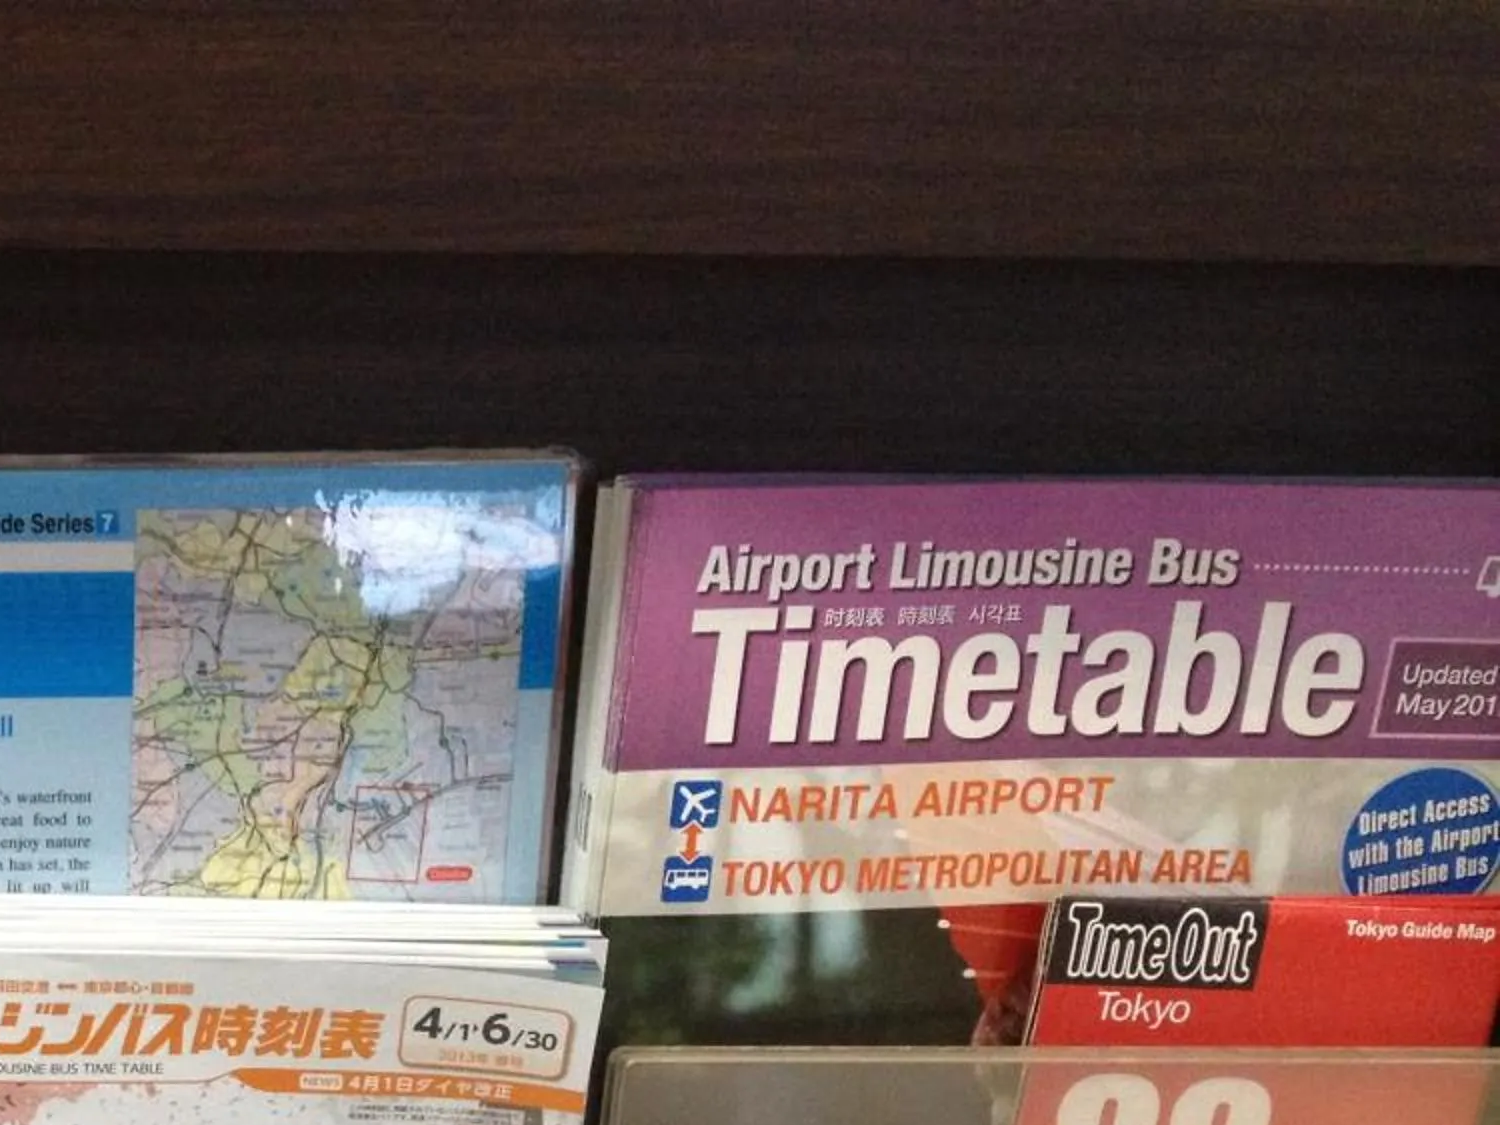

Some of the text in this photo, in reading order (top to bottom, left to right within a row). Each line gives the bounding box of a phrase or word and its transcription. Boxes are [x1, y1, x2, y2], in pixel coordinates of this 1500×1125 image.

[31, 512, 95, 535] Series
[696, 537, 1241, 601] Airport Limousine Bus
[691, 600, 1365, 745] Timetable
[1403, 663, 1498, 689] Updated
[1396, 693, 1500, 720] May 201
[17, 791, 92, 805] waterfront
[729, 776, 1115, 823] NARITA AIRPORT
[33, 812, 67, 826] food
[77, 813, 92, 825] to
[1359, 793, 1490, 836] Direct Access
[0, 837, 38, 851] enjoy
[45, 837, 92, 848] nature
[1349, 820, 1500, 869] with the Airport
[9, 858, 33, 871] has
[68, 857, 91, 870] the
[721, 849, 1253, 897] TOKYO METROPOLITAN AREA
[1358, 856, 1489, 896] Limousine Bus
[61, 879, 89, 892] will
[1346, 919, 1497, 944] Tokyo Guide Map
[1098, 990, 1191, 1030] Tokyo
[51, 1062, 79, 1075] BUS
[84, 1062, 117, 1075] TIME
[122, 1062, 165, 1075] TABLE
